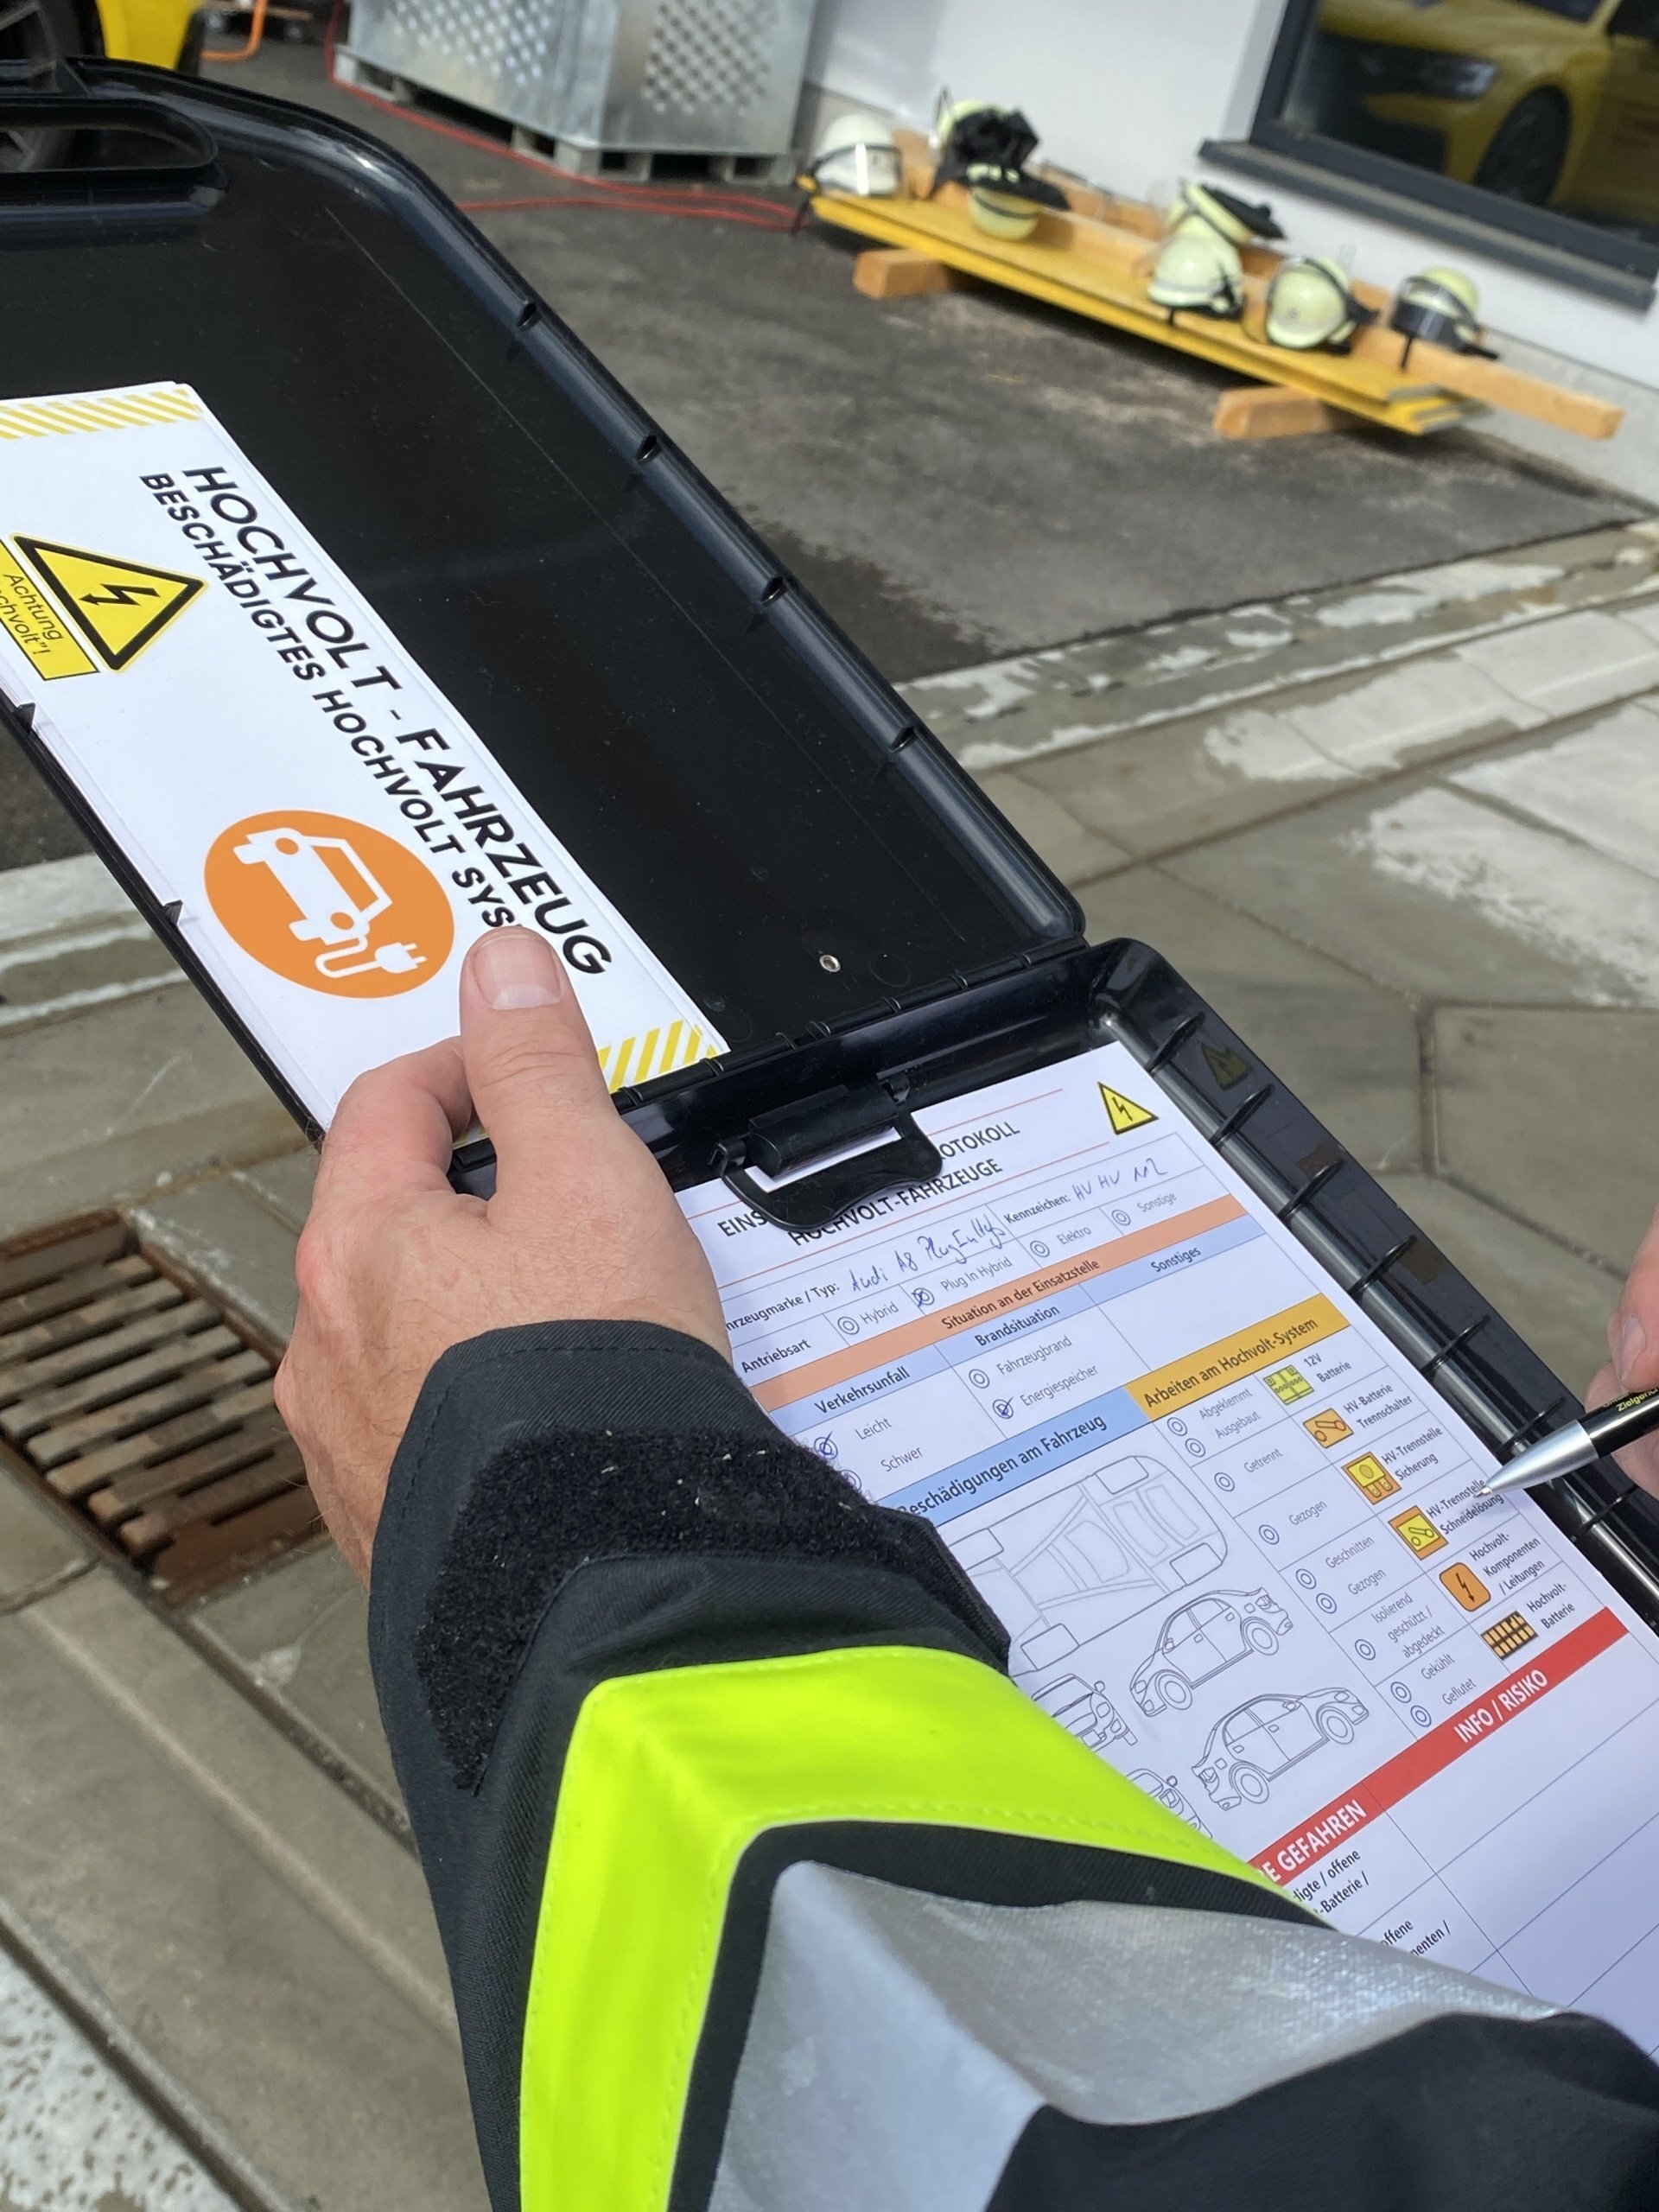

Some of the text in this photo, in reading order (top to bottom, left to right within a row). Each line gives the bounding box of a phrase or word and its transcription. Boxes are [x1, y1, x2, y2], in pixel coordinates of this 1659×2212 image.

[3, 575, 63, 640] Achtung
[140, 474, 522, 927] BESCHÄDIGTES HOCHVOLT SYS
[181, 464, 400, 690] HOCHVOLT
[396, 728, 612, 974] FAHRZEUG
[939, 1122, 1020, 1160] OTOKOLL
[1003, 1194, 1071, 1224] Kennzeichen:
[1136, 1192, 1177, 1212] Sonstige
[1056, 1226, 1091, 1245] Elektro
[940, 1256, 1013, 1291] Plug In Hybrid
[1151, 1247, 1201, 1272] Sonstiges
[810, 1282, 840, 1299] Typ:
[849, 1265, 888, 1292] Audi
[941, 1259, 1100, 1330] Situation an der Einsatzstelle
[860, 1302, 899, 1325] Hybrid
[975, 1305, 1061, 1346] Brandsituation
[741, 1338, 811, 1373] Antriebsart
[996, 1335, 1072, 1375] Fahrzeugbrand
[1144, 1318, 1319, 1408] Arbeiten am Hochvolt-System
[1303, 1353, 1322, 1368] 12V
[1020, 1365, 1098, 1407] Energiespeicher
[1316, 1361, 1351, 1382] Batterie
[814, 1365, 910, 1414] Verkehrsunfall
[1198, 1388, 1253, 1420] Abgeklemmt
[1343, 1383, 1393, 1414] HV-Batterie
[1215, 1410, 1261, 1439] Ausgebaut
[1357, 1395, 1413, 1429] Trennschalter
[855, 1417, 892, 1440] Leicht
[1018, 1446, 1043, 1465] am
[1039, 1415, 1107, 1452] Fahrzeug
[880, 1446, 923, 1471] Schwer
[1243, 1448, 1283, 1473] Getrennt
[1381, 1427, 1442, 1465] HV-Trennstelle
[1395, 1453, 1439, 1481] Sicherung
[1288, 1500, 1327, 1526] Gezogen
[1427, 1478, 1485, 1519] HV-Trennstelle
[1440, 1493, 1504, 1535] Schneidelösung
[1325, 1535, 1375, 1568] Geschnitten
[1469, 1532, 1510, 1561] Hochvolt-
[1483, 1536, 1541, 1577] Komponenten
[1347, 1568, 1387, 1595] Gezogen
[1503, 1560, 1545, 1591] Leitungen
[1370, 1592, 1413, 1624] Isolierend
[1526, 1582, 1567, 1612] Hochvolt-
[1388, 1610, 1428, 1643] geschützt
[1541, 1602, 1575, 1629] Batterie
[1402, 1625, 1446, 1658] abgedeckt
[1421, 1653, 1456, 1680] Gekühlt
[1442, 1678, 1477, 1706] Geflutet
[1453, 1708, 1493, 1743] INFO
[1498, 1669, 1548, 1712] RISIKO
[1277, 1799, 1367, 1872] GEFAHREN
[1327, 1851, 1361, 1878] offene
[1315, 1879, 1363, 1913] -Batterie
